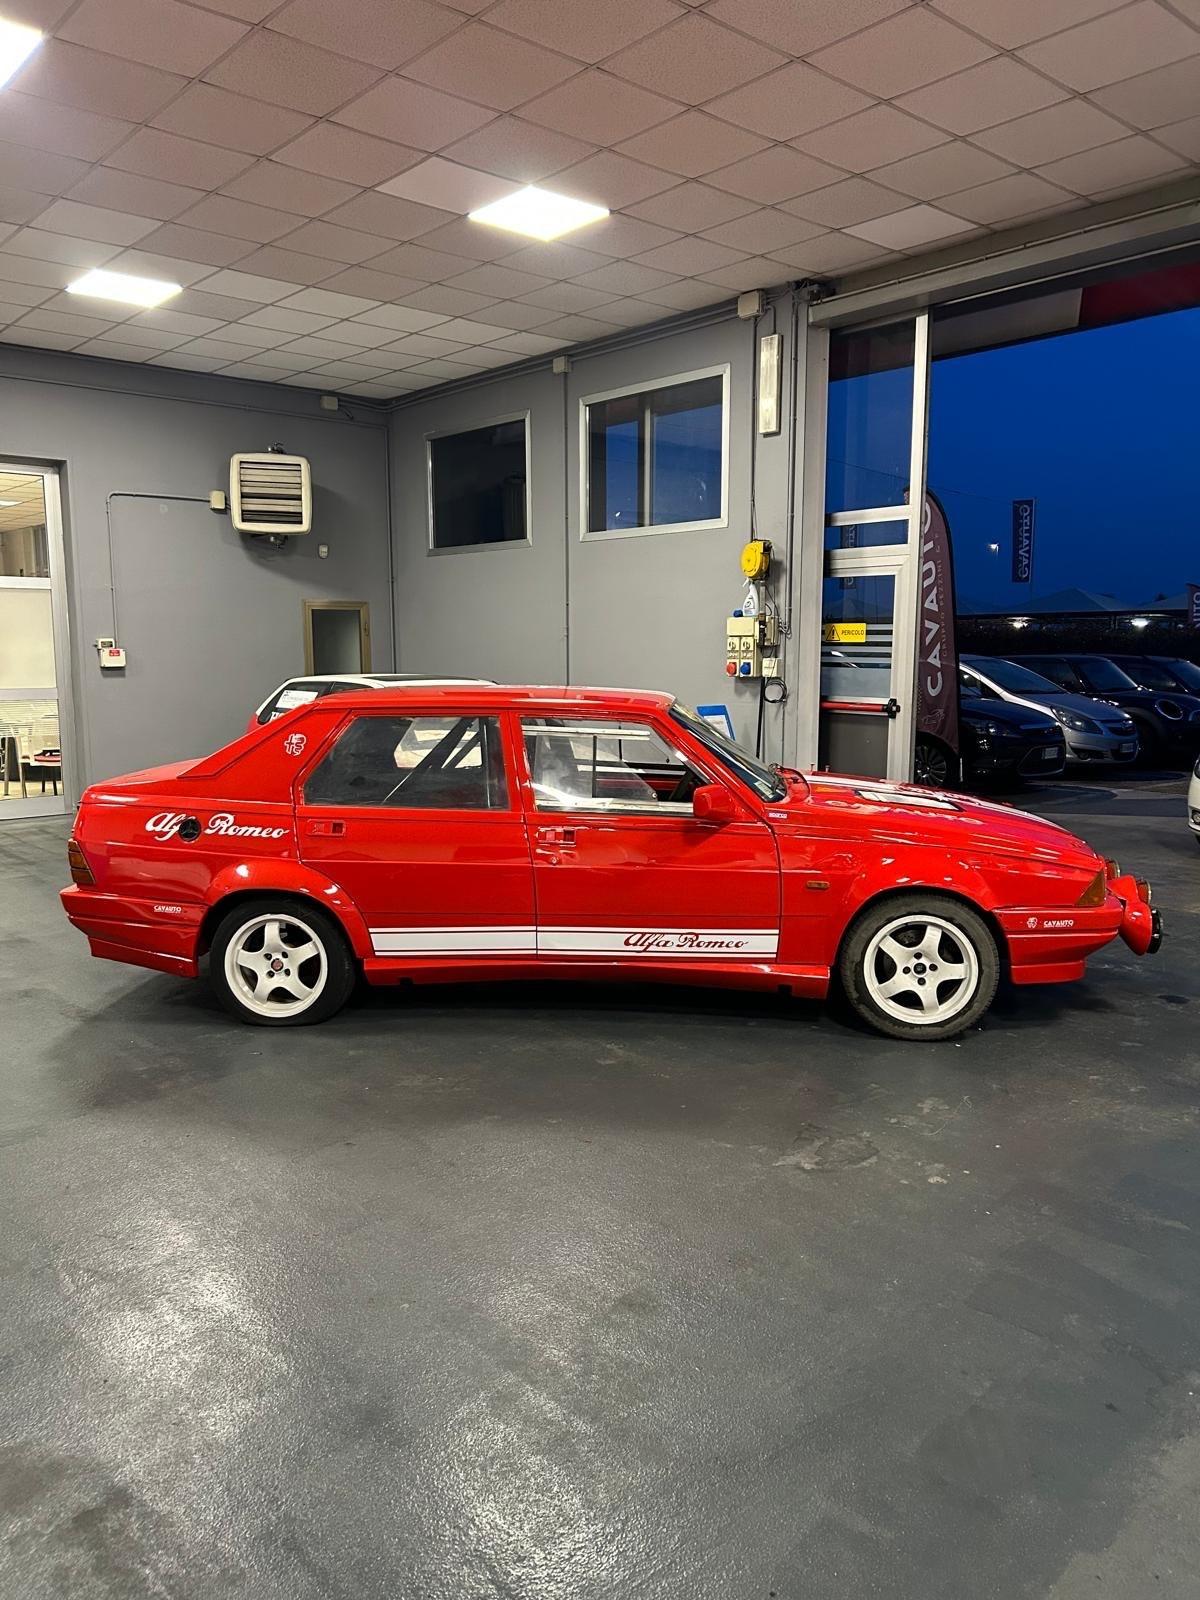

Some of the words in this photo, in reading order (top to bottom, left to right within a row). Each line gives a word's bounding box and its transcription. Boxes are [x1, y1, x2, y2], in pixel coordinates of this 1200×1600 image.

[145, 812, 197, 842] Alf
[204, 813, 289, 838] Romeo
[1043, 919, 1074, 927] CAVAUTO
[624, 932, 674, 953] Alfa
[677, 932, 749, 949] Romeo
